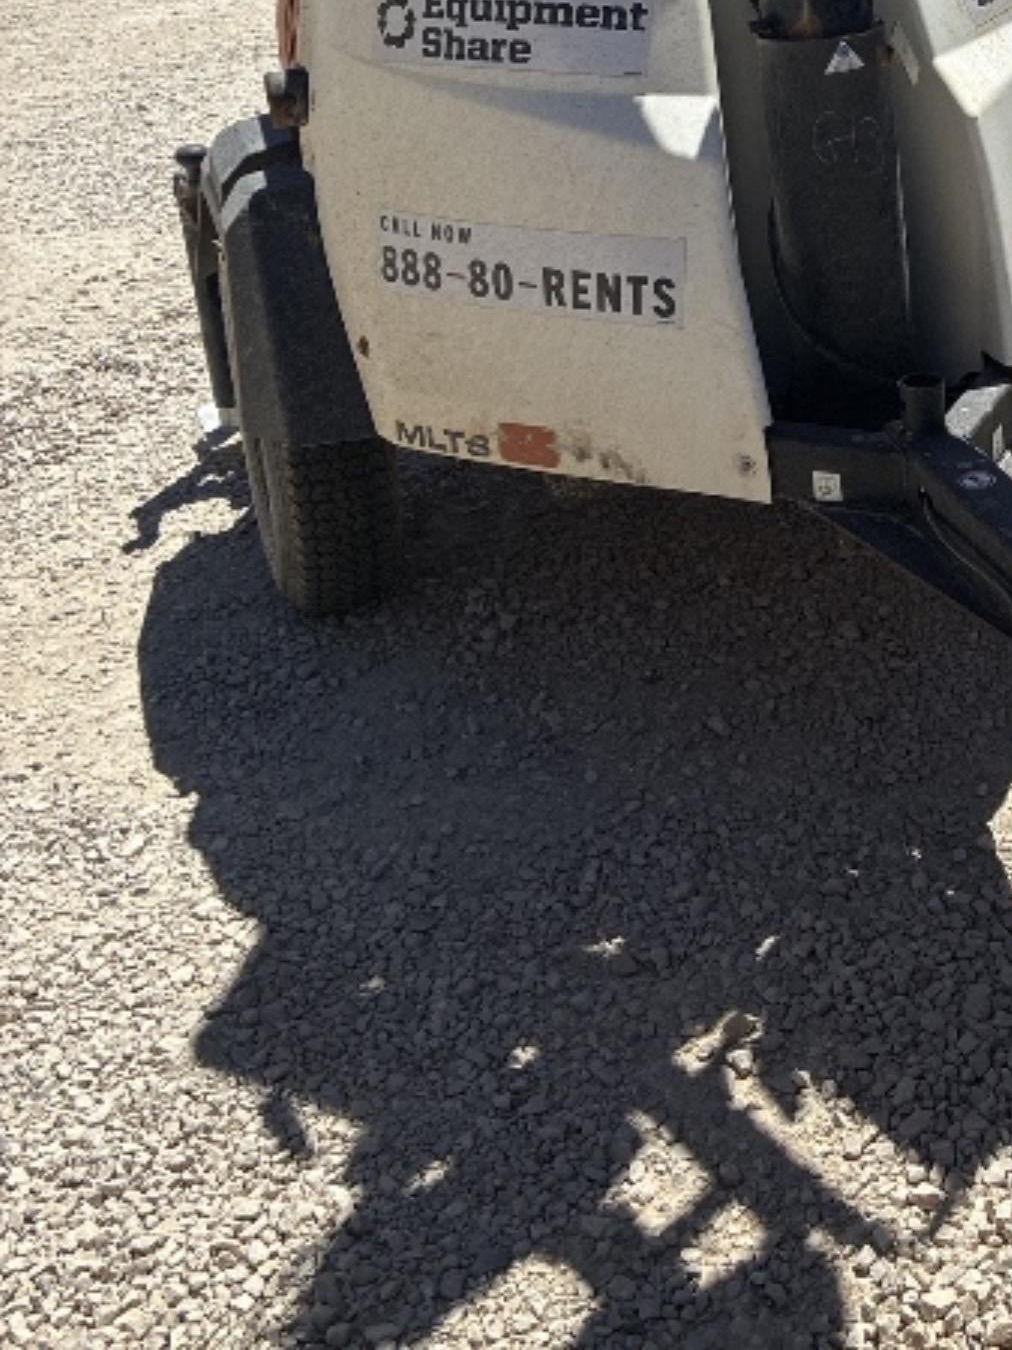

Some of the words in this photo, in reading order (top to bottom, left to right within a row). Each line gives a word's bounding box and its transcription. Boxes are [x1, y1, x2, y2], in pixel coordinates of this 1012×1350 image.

[421, 27, 532, 63] Share
[380, 215, 421, 238] CALL
[431, 222, 472, 244] NOW
[381, 245, 677, 320] 888-80-RENTS
